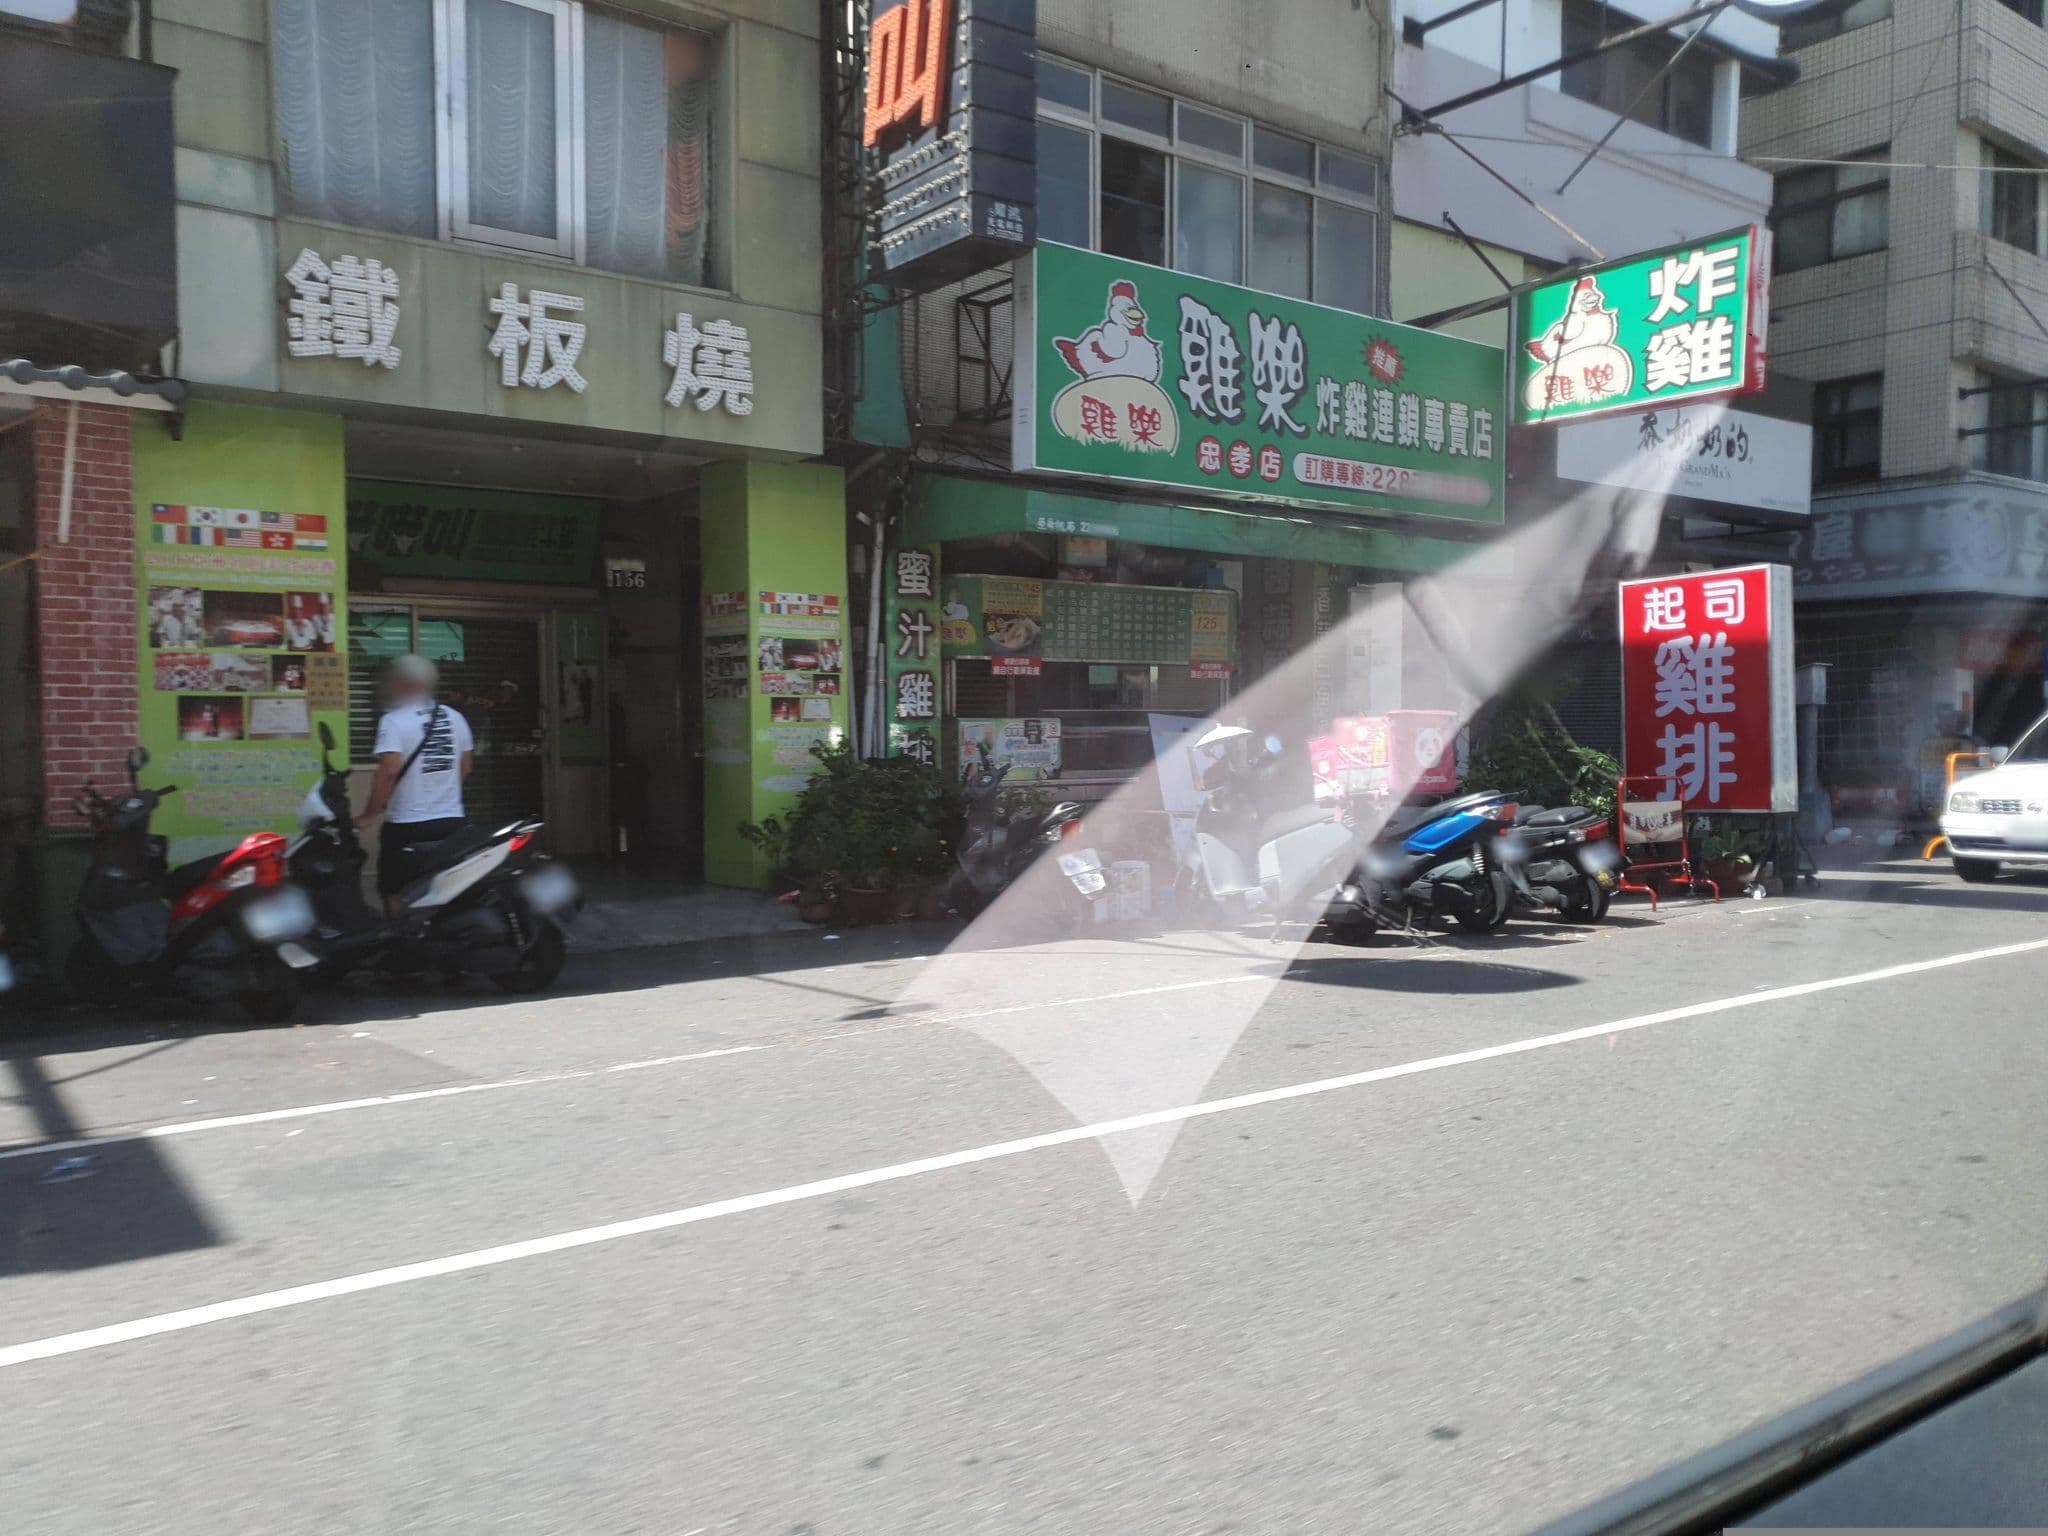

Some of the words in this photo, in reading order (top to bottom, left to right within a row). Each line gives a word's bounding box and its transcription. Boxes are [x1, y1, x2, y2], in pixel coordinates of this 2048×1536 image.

[284, 247, 754, 416] 鐵板燒
[1646, 246, 1739, 393] 炸雞
[1198, 440, 1282, 480] 忠孝店
[1316, 376, 1493, 460] 炸雞連鎖專賣店
[1643, 578, 1745, 633] 起司
[1654, 631, 1738, 803] 雞排
